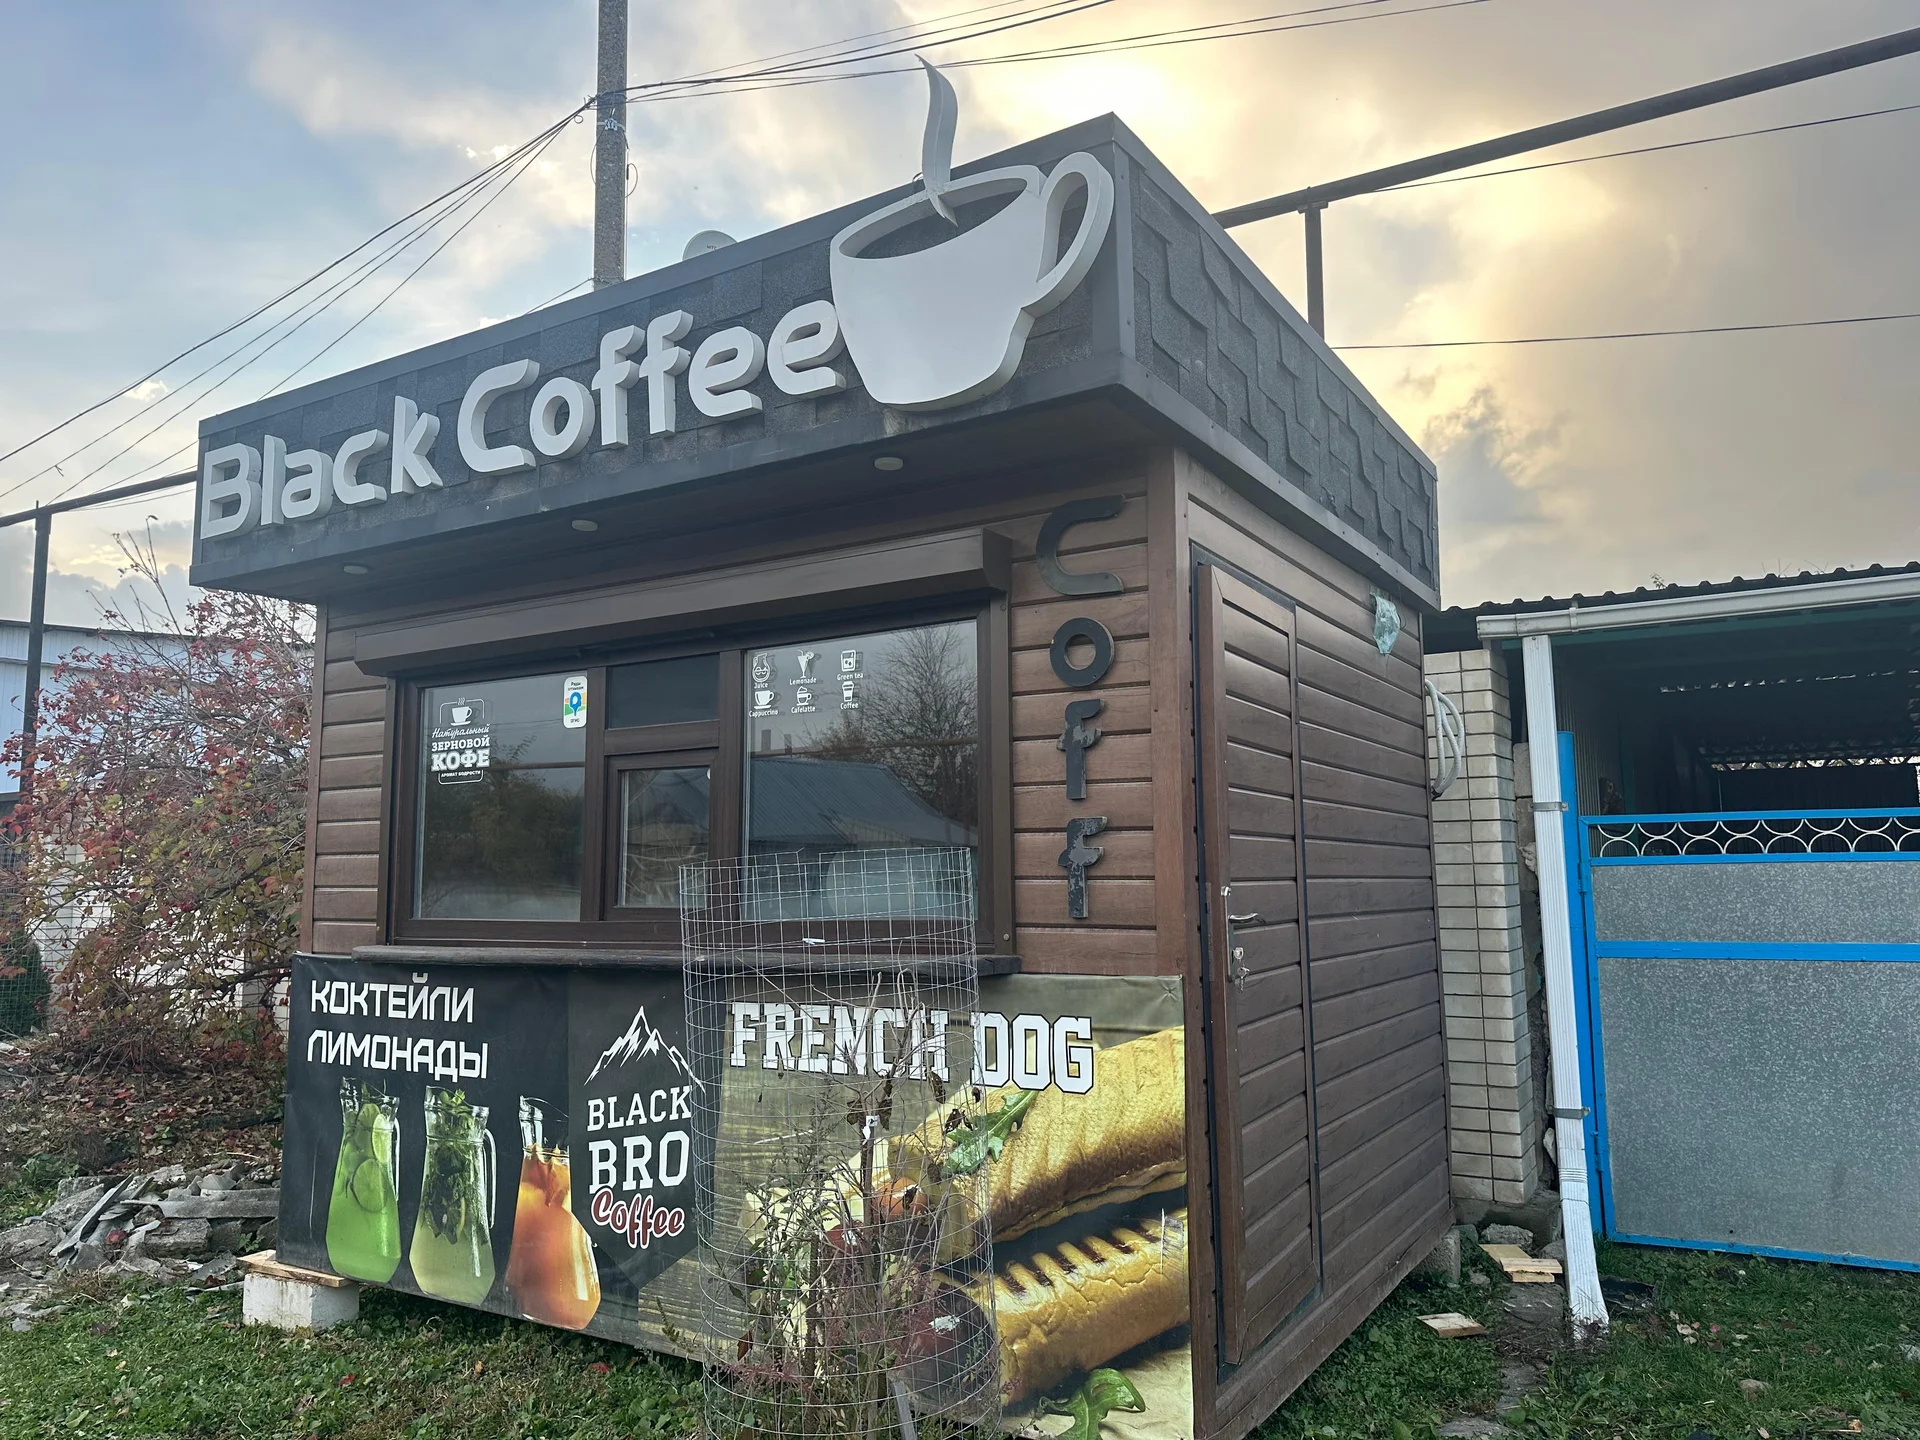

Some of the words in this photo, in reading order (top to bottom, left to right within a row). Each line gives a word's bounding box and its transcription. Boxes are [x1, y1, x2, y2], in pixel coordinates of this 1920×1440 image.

[200, 396, 444, 540] Black
[457, 299, 847, 475] Coffee
[789, 677, 817, 685] Lemonade
[837, 673, 853, 681] Green
[748, 709, 779, 718] Cappuccino
[791, 706, 816, 714] Cafelatte
[840, 702, 859, 710] Coffee
[431, 723, 491, 739] Натуральный
[431, 734, 491, 752] ЗЕРНОВОЙ
[430, 748, 491, 772] КОФЕ
[310, 972, 475, 1024] КОКТЕЙЛИ
[306, 1029, 488, 1082] ЛИМОНАДЫ
[729, 1001, 950, 1083] FRENCH
[969, 1010, 1094, 1096] DOG
[586, 1085, 693, 1132] BLACK
[587, 1130, 690, 1195] BRO
[590, 1187, 686, 1250] Coffee
